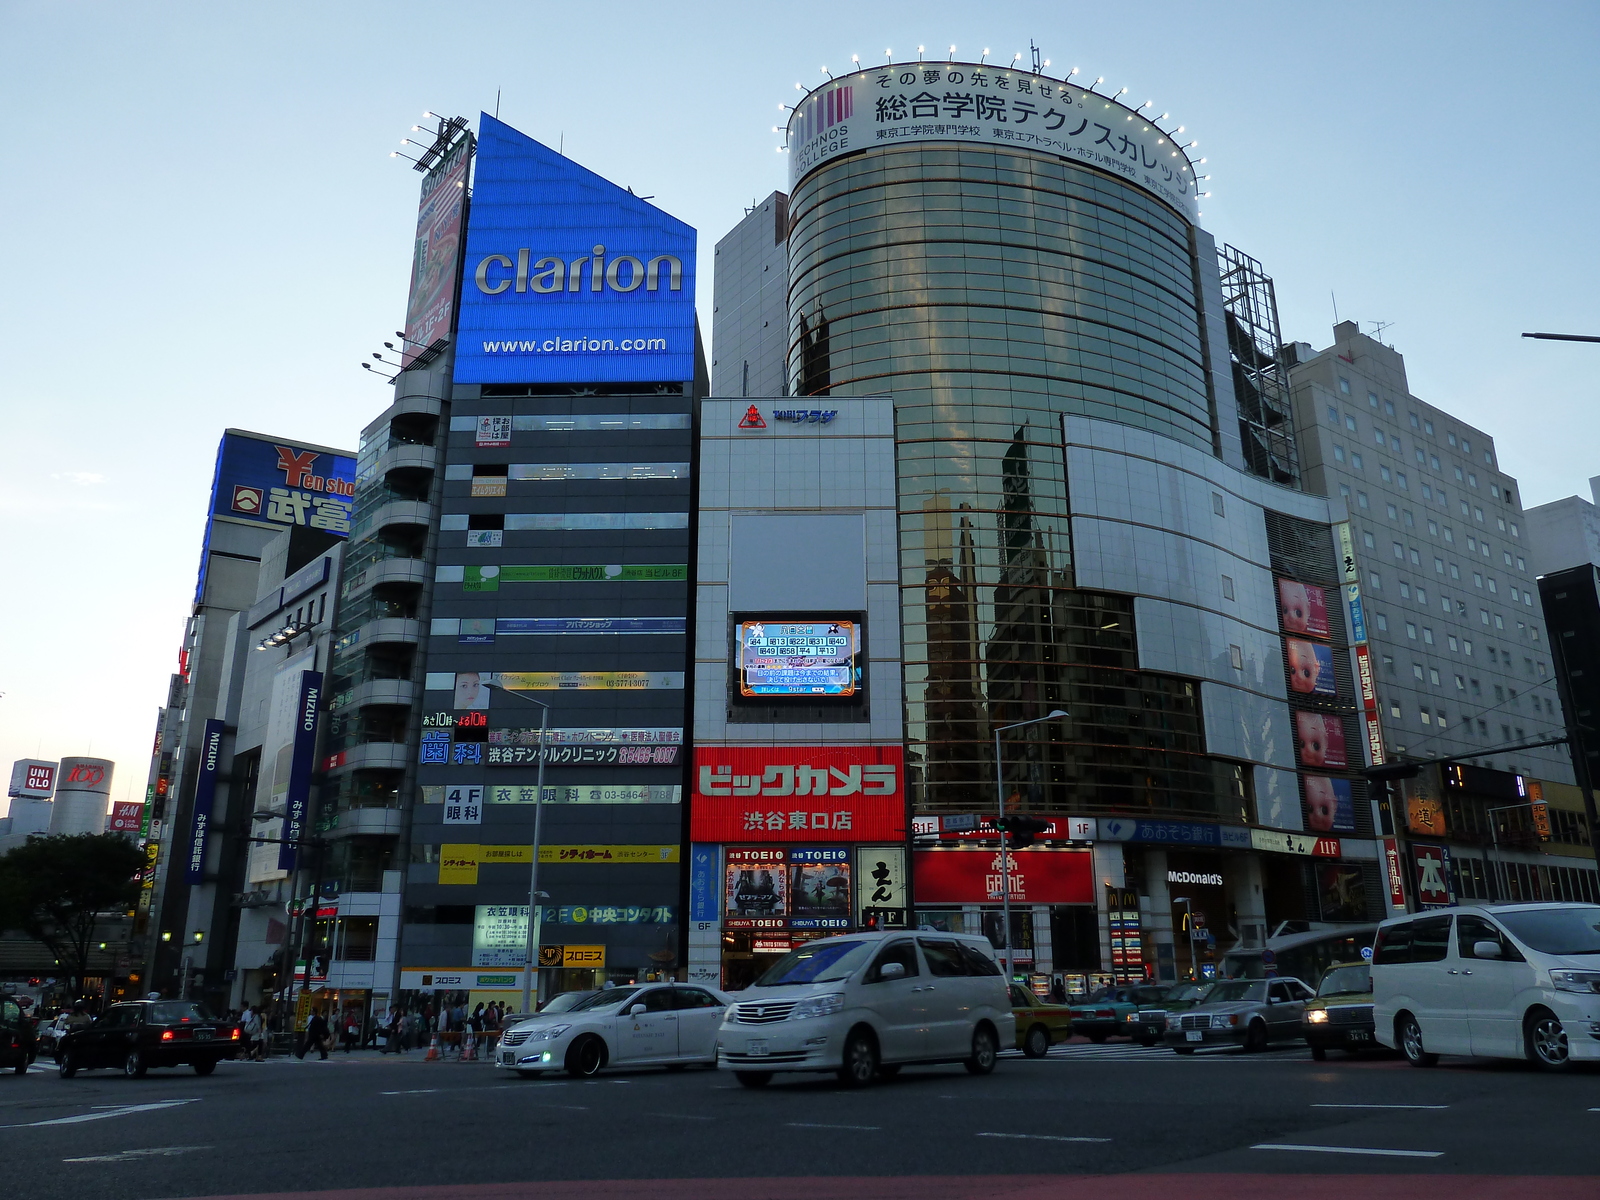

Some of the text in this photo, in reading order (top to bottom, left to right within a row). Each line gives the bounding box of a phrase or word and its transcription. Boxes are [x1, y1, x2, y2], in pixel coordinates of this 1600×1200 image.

[876, 69, 1084, 109] その夢の先を見せる。
[876, 123, 981, 140] 東京工学院専門学校
[795, 125, 849, 166] TECHNOS
[875, 91, 1188, 195] 総合学院テクノスカレッジ
[795, 138, 849, 179] COLLEGE
[475, 244, 683, 295] clarion
[482, 335, 667, 353] www.clarion.com
[672, 569, 683, 578] 8F
[566, 620, 613, 629] アパマンショップ
[605, 679, 650, 688] 03-5774-3077
[303, 686, 318, 732] MIZUHO
[206, 731, 221, 771] MIZUHO
[30, 767, 50, 778] UNI
[66, 767, 105, 788] 109
[698, 764, 897, 797] ビックカメラ
[28, 778, 49, 788] QLO
[496, 787, 580, 802] 衣笠眼科
[446, 806, 479, 821] 眼科
[743, 811, 853, 831] 渋谷東口店
[1076, 823, 1089, 833] 1F
[1140, 822, 1215, 844] あおぞら銀行
[485, 850, 523, 858] お部屋探しは
[559, 849, 613, 860] シティホーム
[617, 851, 655, 859] 渋谷センター
[1319, 839, 1338, 855] 11F
[1167, 870, 1223, 886] McDonald's
[1417, 851, 1447, 898] 本
[985, 874, 1026, 893] GAME
[487, 906, 530, 917] 衣笠眼科
[546, 908, 569, 923] 2F
[589, 907, 673, 923] 中央コンタクト
[698, 922, 711, 931] 6F
[565, 951, 604, 962] プロミス
[435, 976, 462, 985] プロミス
